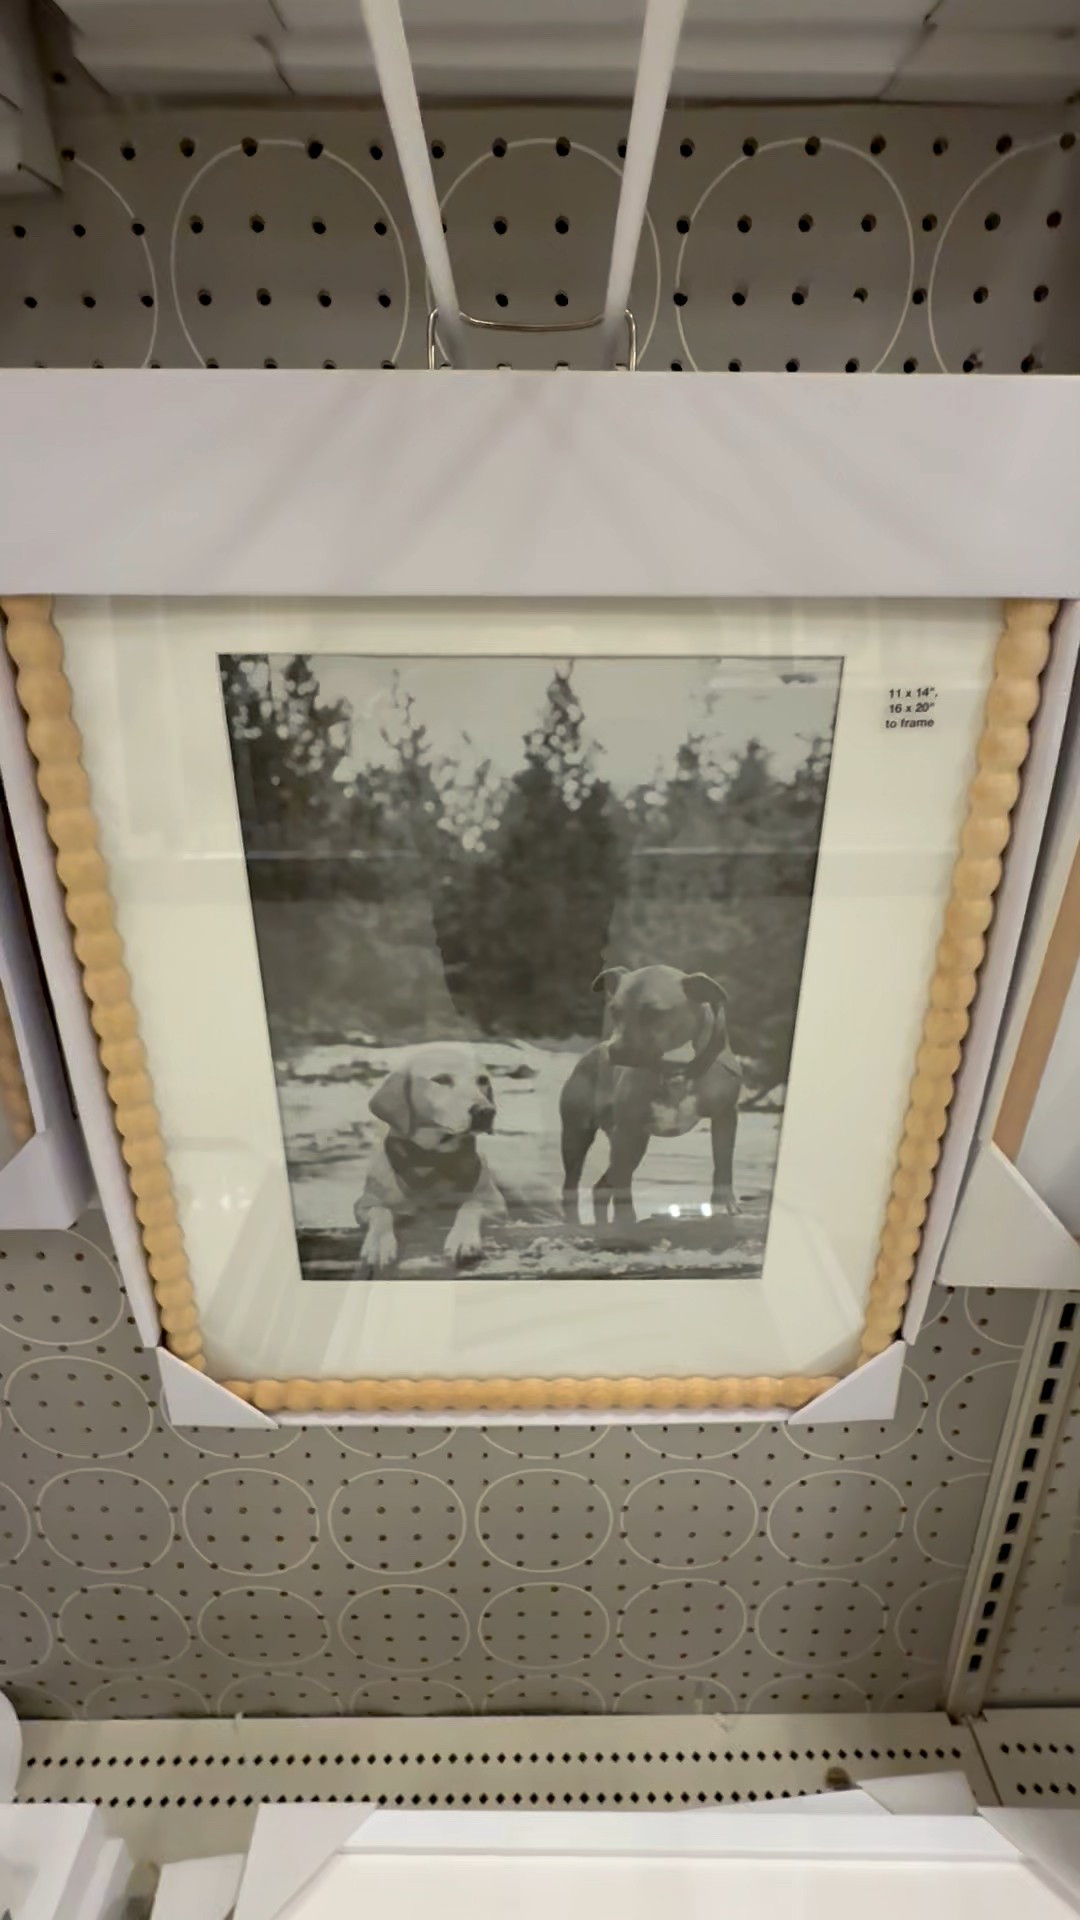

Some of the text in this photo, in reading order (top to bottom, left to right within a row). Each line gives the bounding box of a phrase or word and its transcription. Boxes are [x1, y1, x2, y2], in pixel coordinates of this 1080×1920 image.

[889, 688, 901, 699] 11
[905, 690, 912, 698] x
[889, 703, 902, 713] 16
[905, 704, 912, 713] x
[885, 718, 935, 729] to frame
